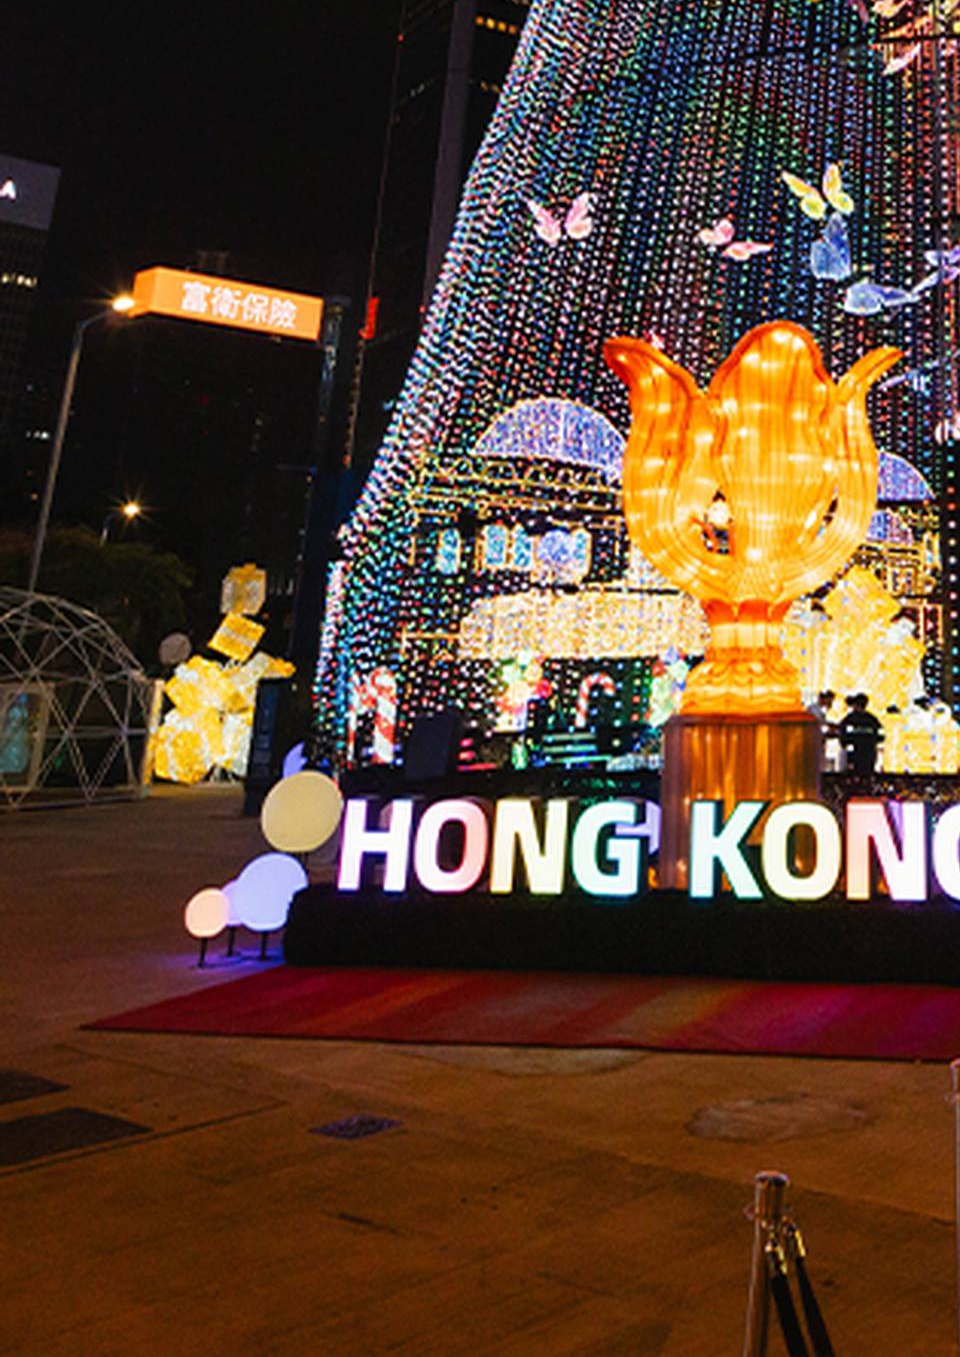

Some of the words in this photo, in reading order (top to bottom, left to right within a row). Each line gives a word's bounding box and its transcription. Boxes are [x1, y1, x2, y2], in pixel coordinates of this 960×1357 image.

[181, 281, 297, 329] 富衛保險
[337, 798, 642, 896] HONG
